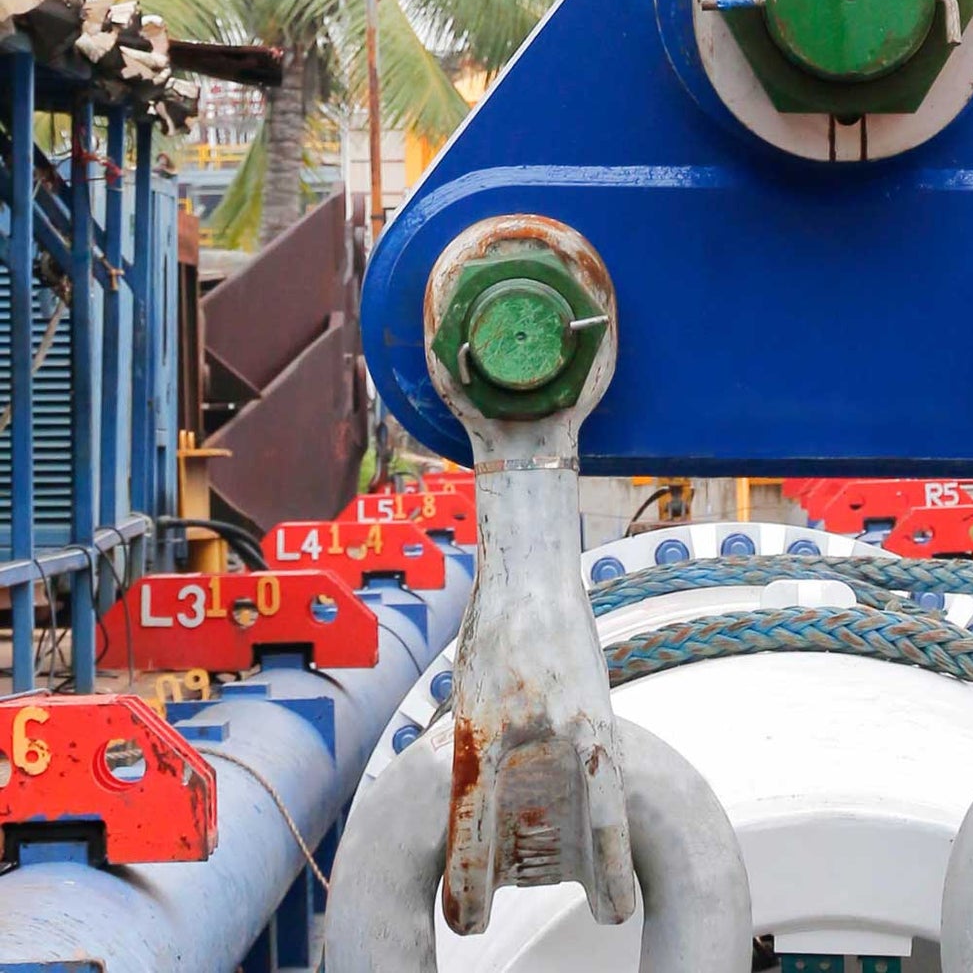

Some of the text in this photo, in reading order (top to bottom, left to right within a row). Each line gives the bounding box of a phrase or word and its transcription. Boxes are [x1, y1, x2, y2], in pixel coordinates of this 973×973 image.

[925, 482, 960, 507] R5
[357, 499, 394, 523] L5
[276, 528, 322, 561] L4
[141, 584, 206, 628] L3
